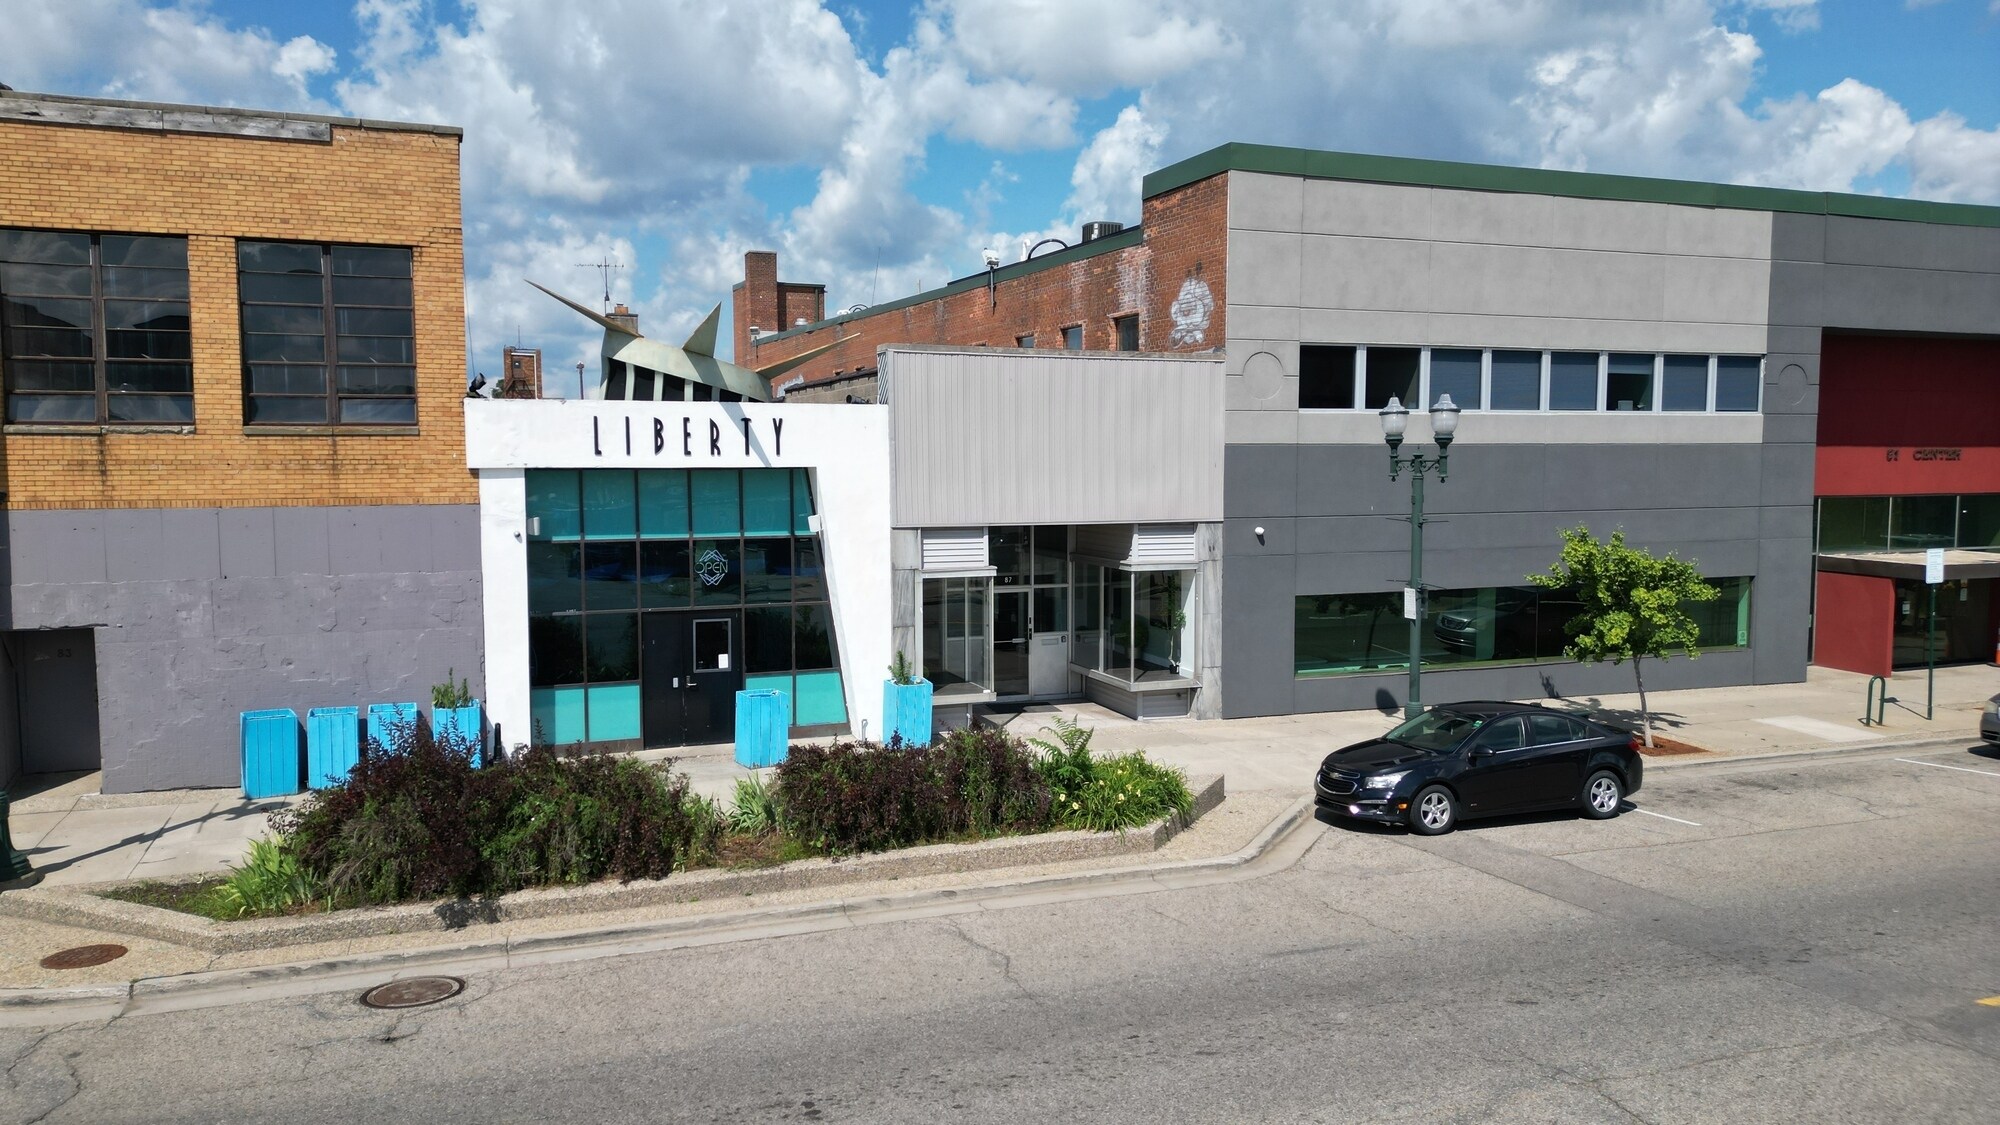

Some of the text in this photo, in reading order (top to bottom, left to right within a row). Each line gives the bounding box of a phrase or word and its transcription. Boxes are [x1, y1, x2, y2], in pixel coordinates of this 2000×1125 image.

[593, 415, 784, 457] LIBERTY
[694, 560, 728, 574] OPEN
[57, 648, 72, 658] 83
